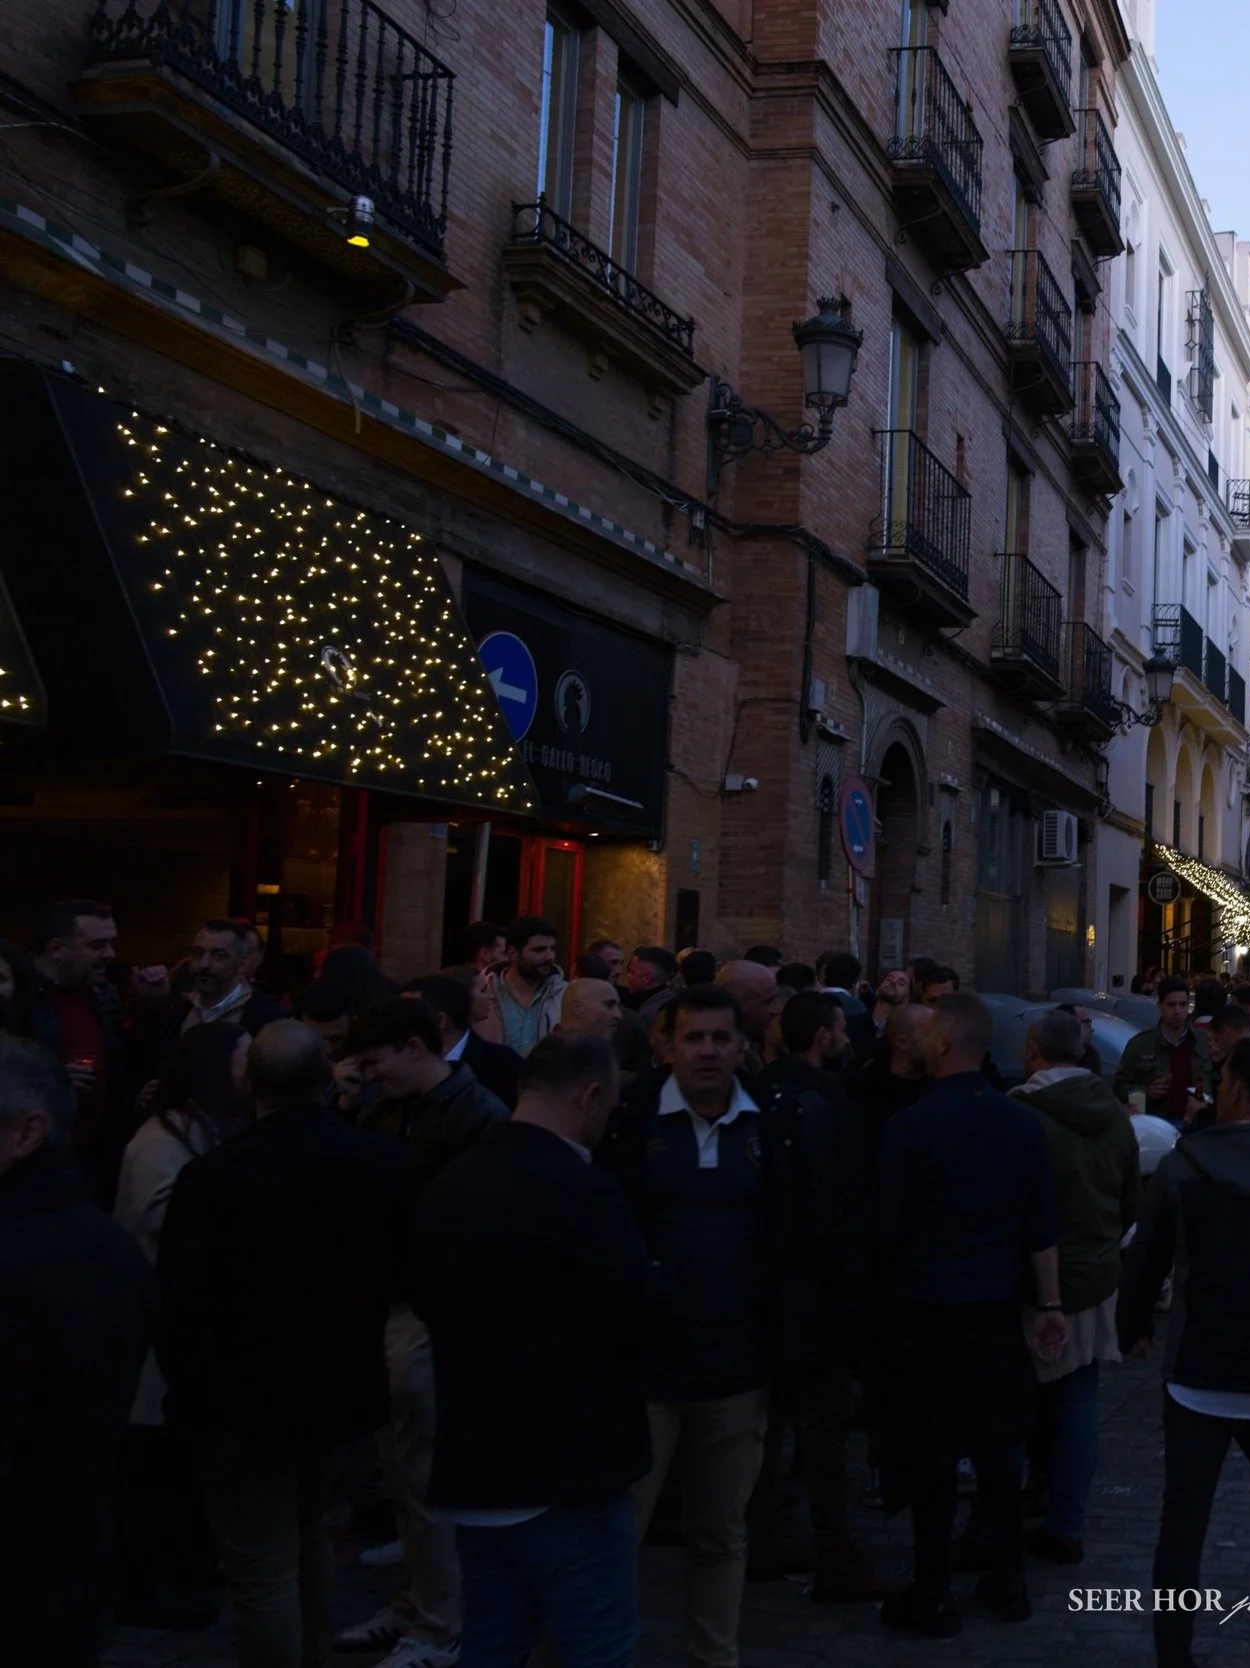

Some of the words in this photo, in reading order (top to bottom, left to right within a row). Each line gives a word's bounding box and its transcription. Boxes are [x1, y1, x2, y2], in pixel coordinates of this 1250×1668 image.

[523, 739, 535, 763] EL
[541, 745, 575, 773] GALLO
[580, 754, 612, 783] NEGRO
